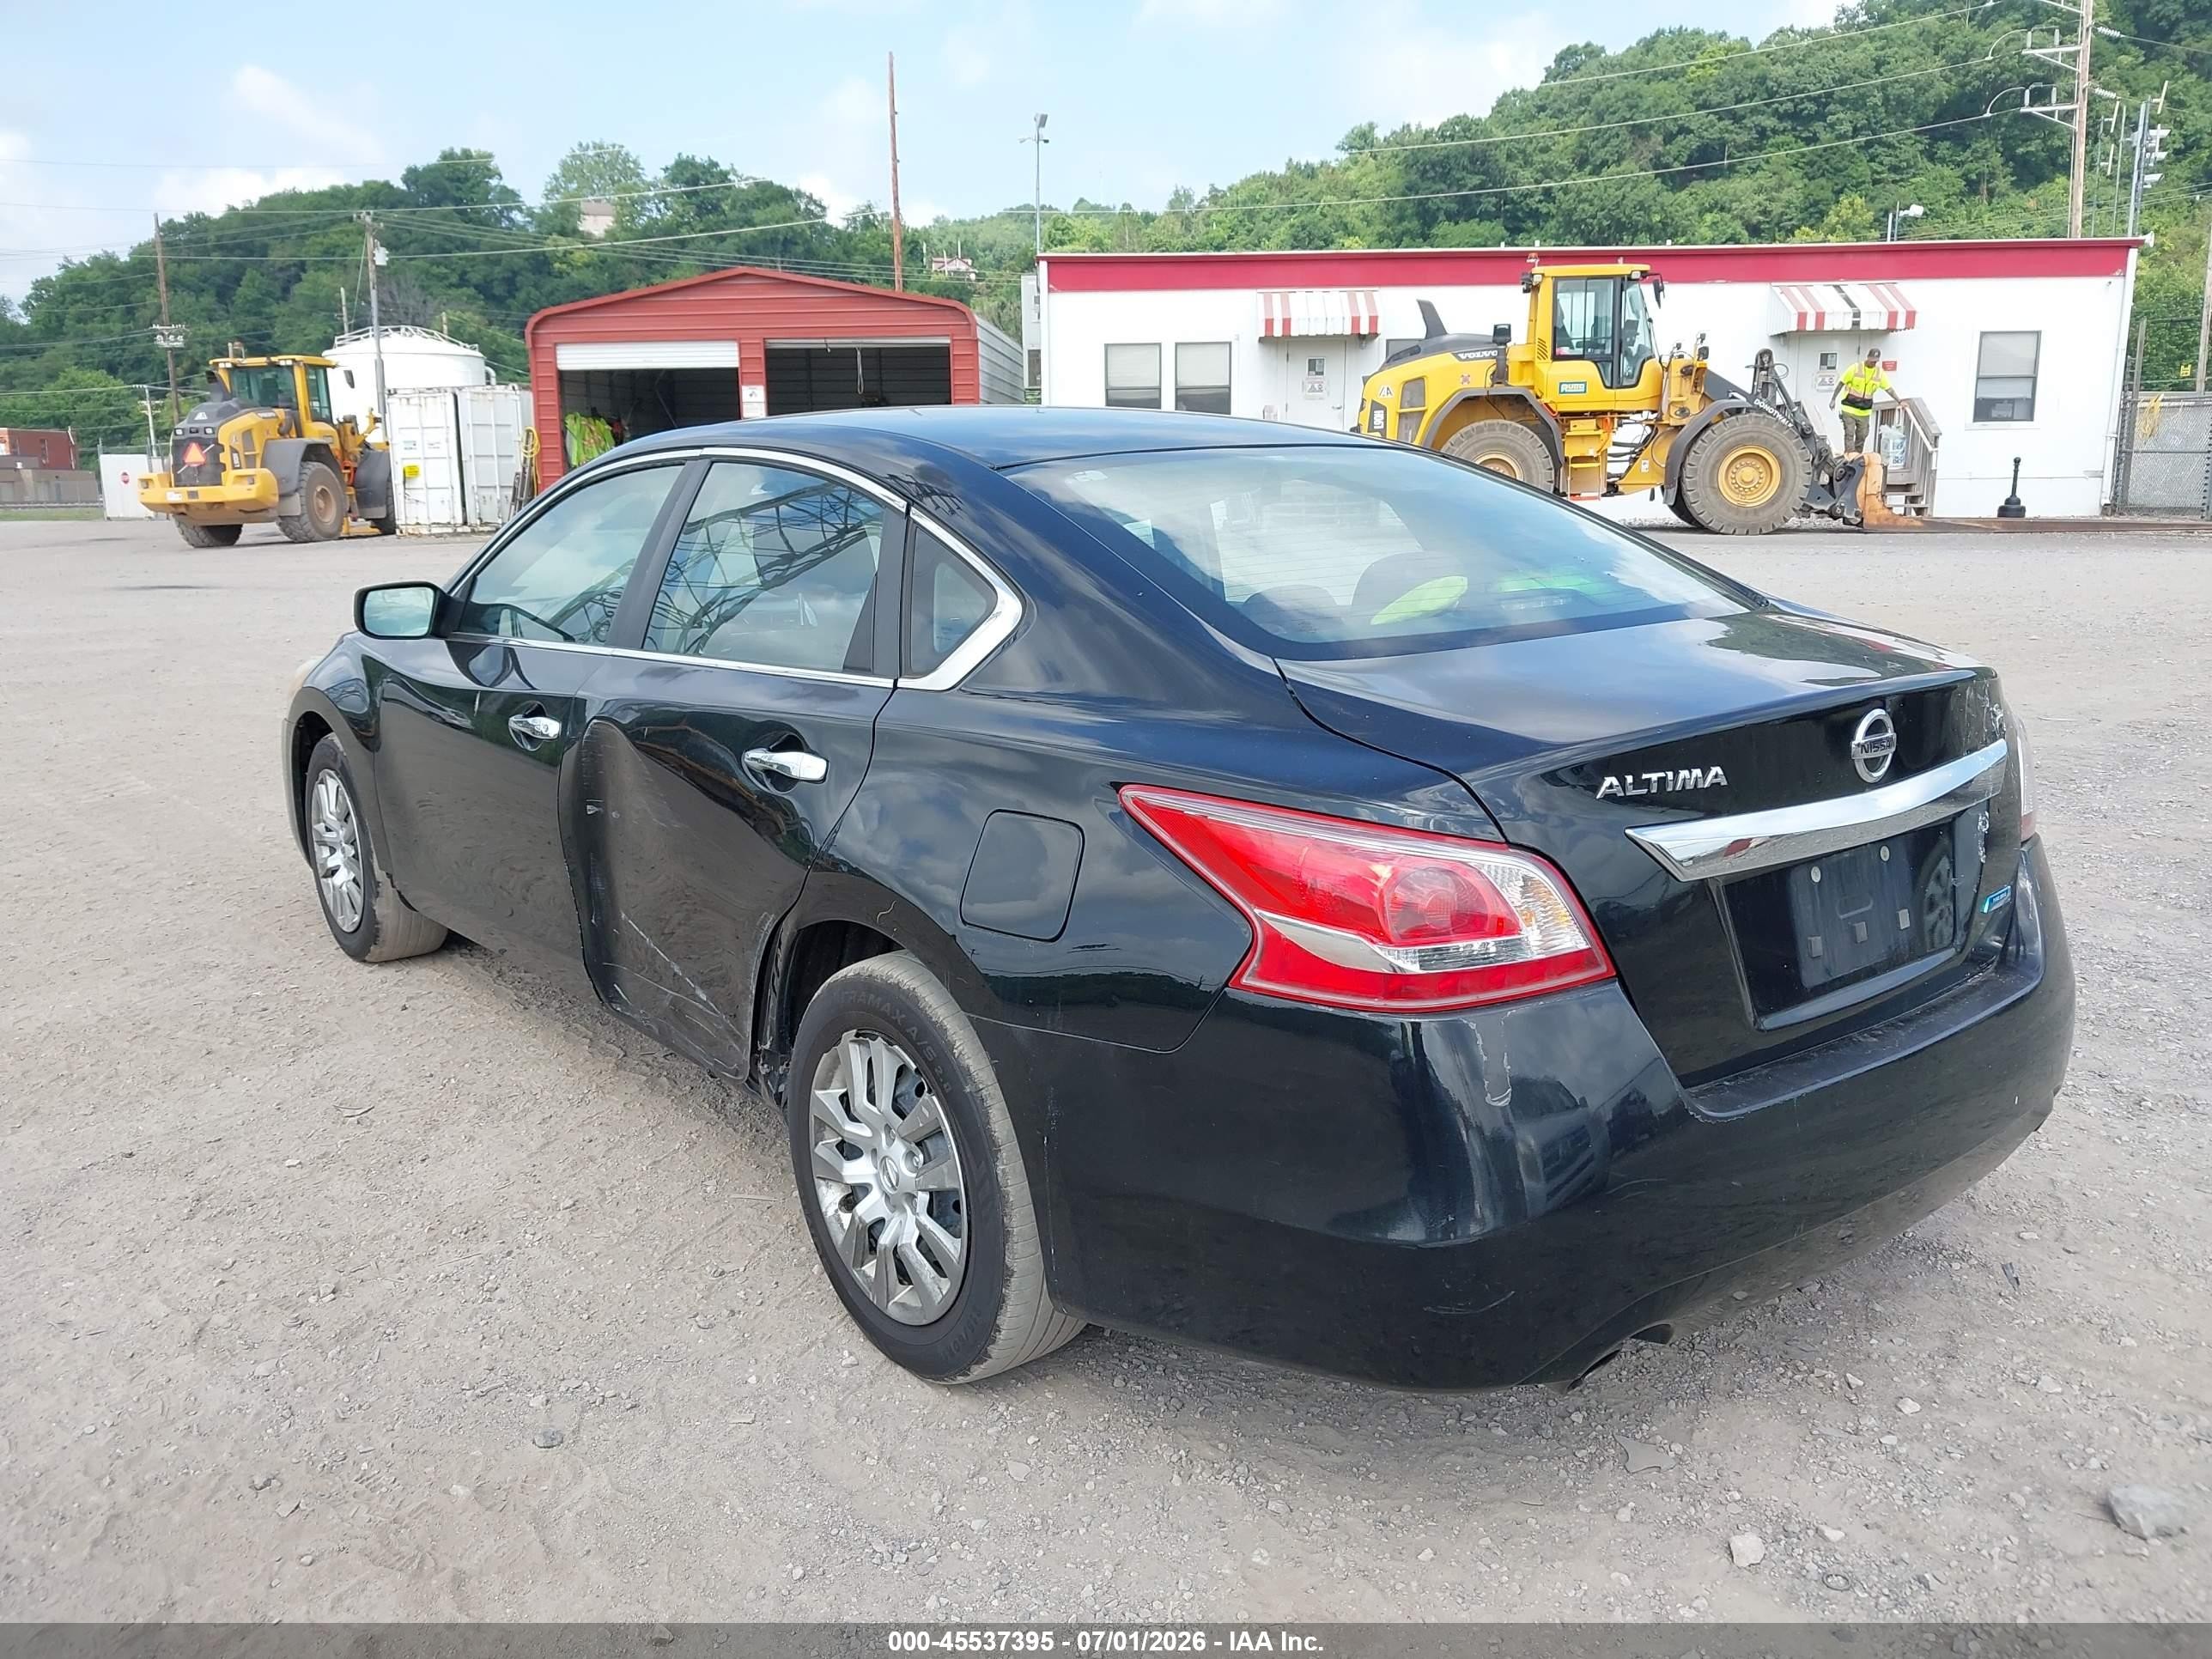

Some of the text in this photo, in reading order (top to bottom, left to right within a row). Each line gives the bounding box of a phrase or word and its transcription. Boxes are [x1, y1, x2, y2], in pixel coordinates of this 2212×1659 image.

[1457, 349, 1498, 359] VOLVO
[1374, 410, 1384, 429] L90H
[1861, 736, 1895, 754] NISSAN
[1595, 766, 1729, 799] ALTIMA
